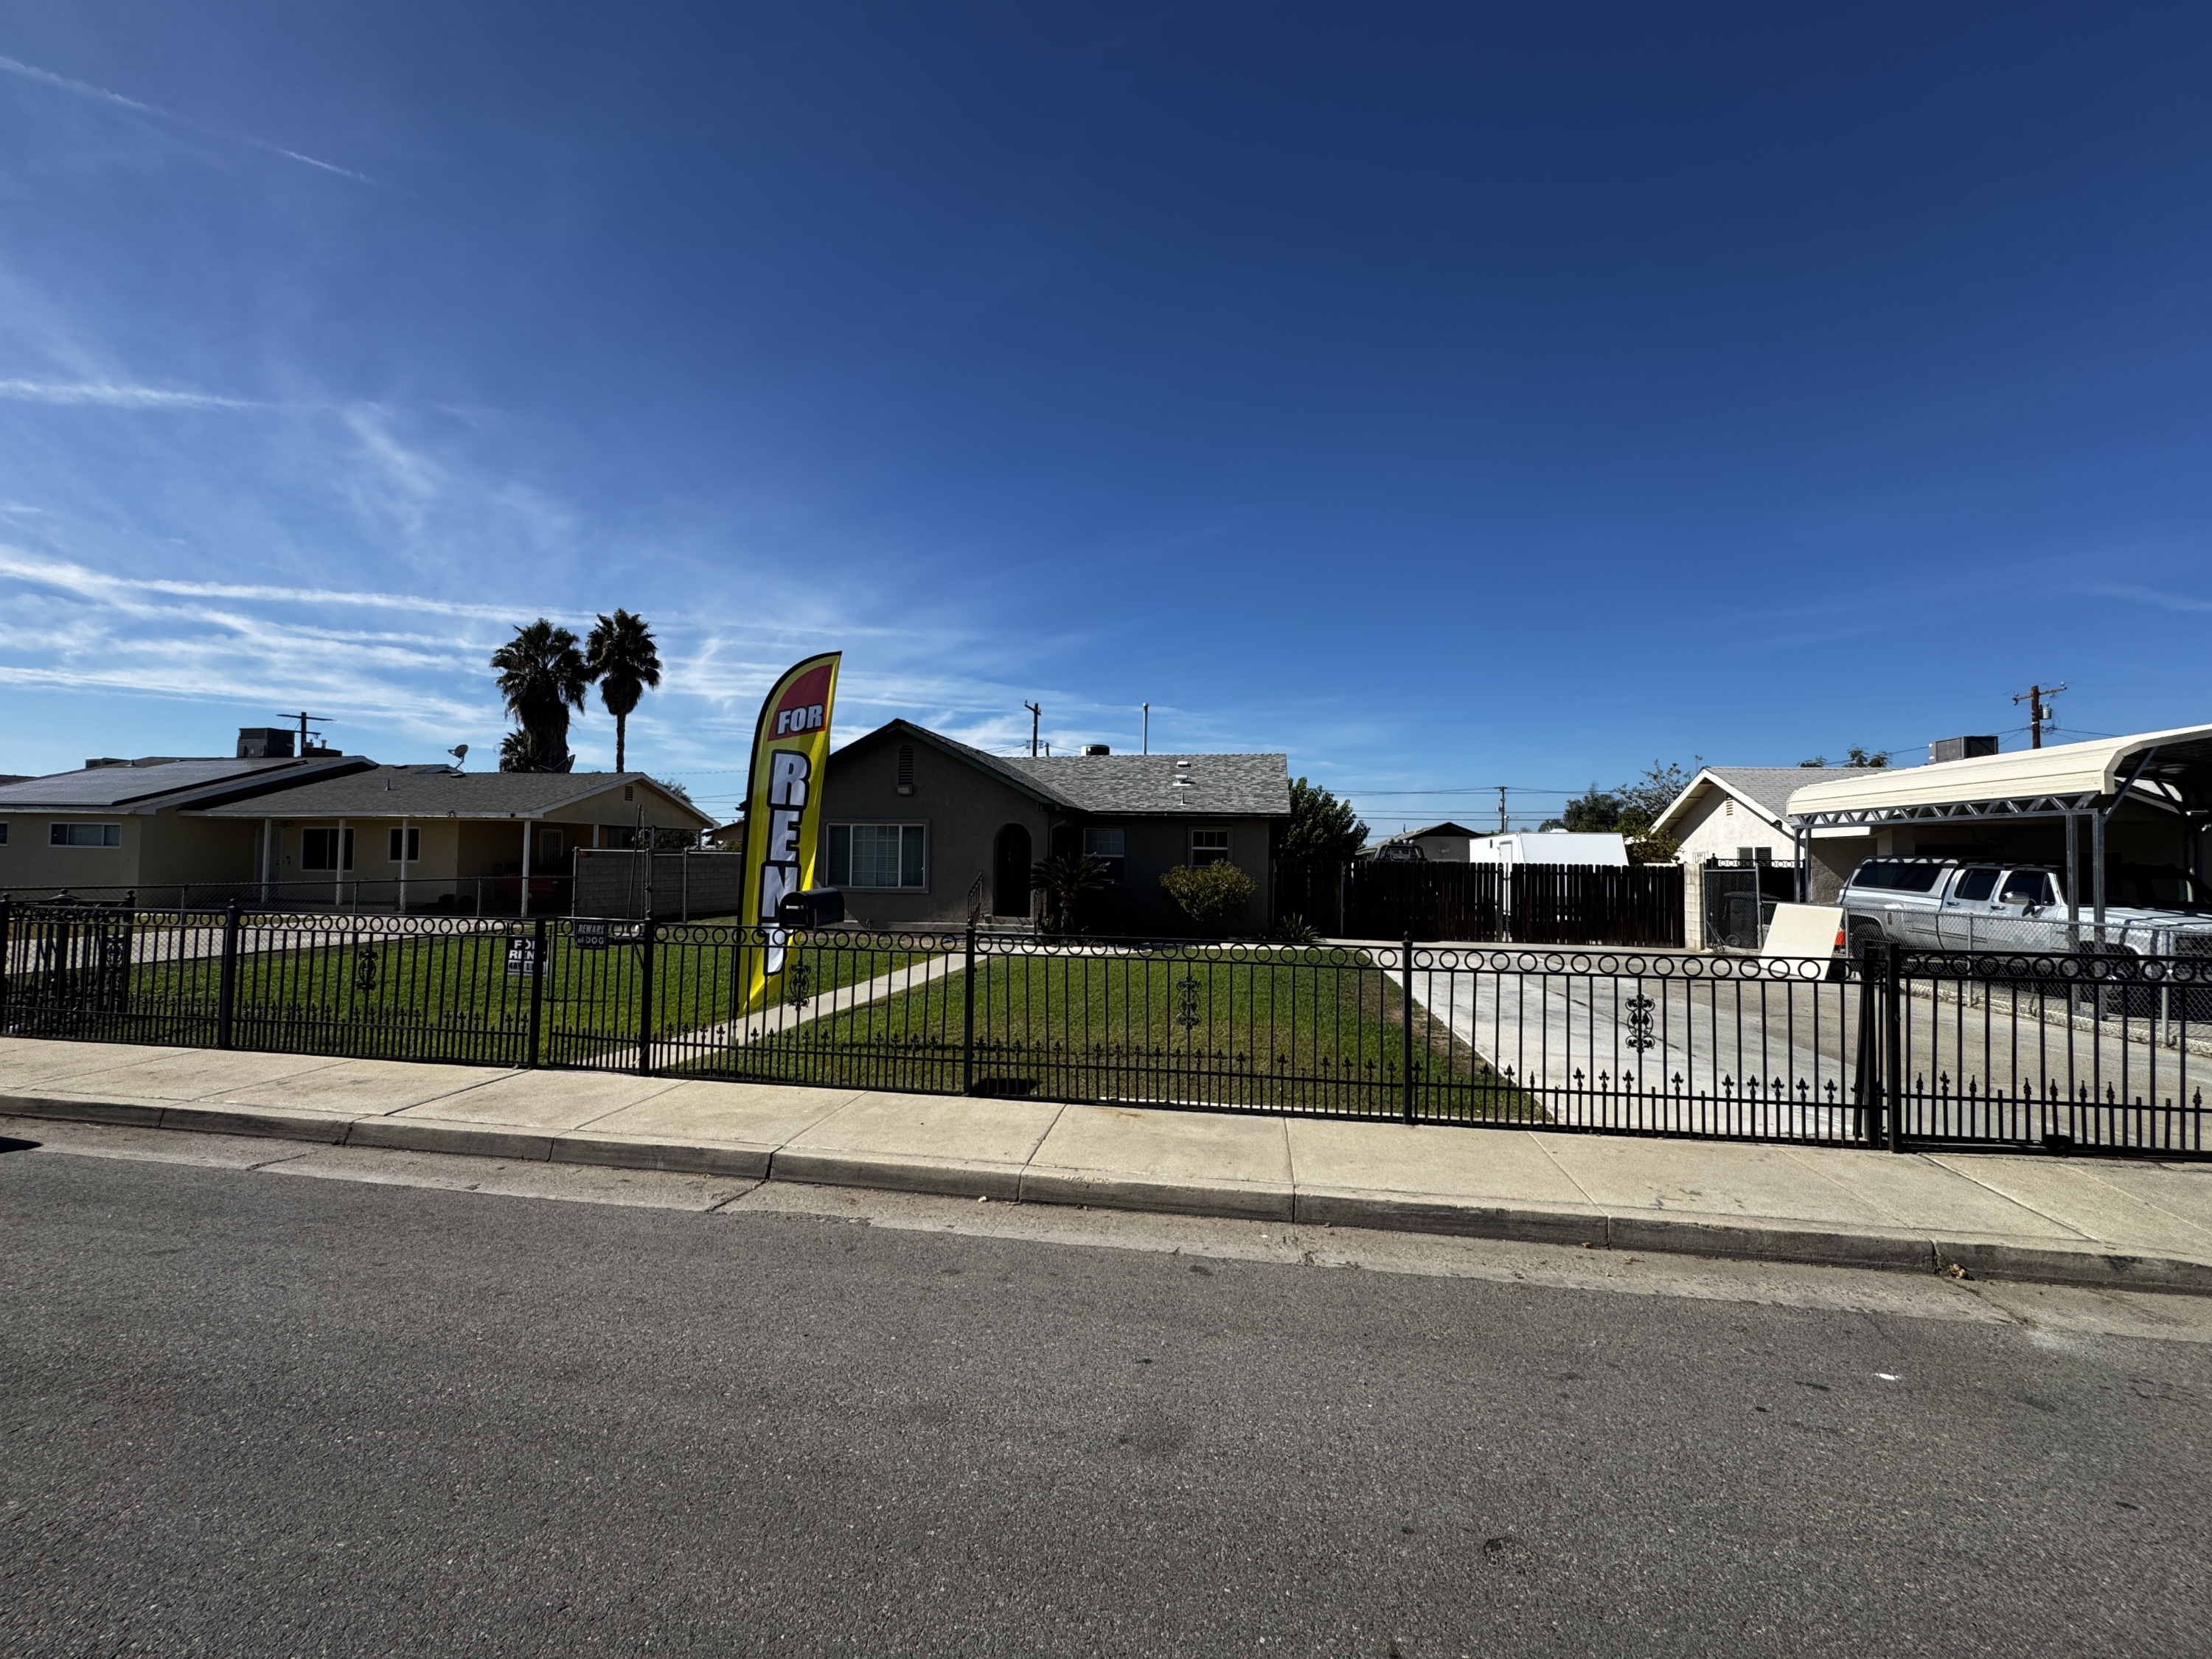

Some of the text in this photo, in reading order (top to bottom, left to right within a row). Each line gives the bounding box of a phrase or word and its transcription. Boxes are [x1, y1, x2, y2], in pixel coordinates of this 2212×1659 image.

[778, 705, 822, 734] FOR
[760, 753, 807, 974] RENT
[578, 924, 605, 933] BEWARE
[585, 936, 604, 945] DOG
